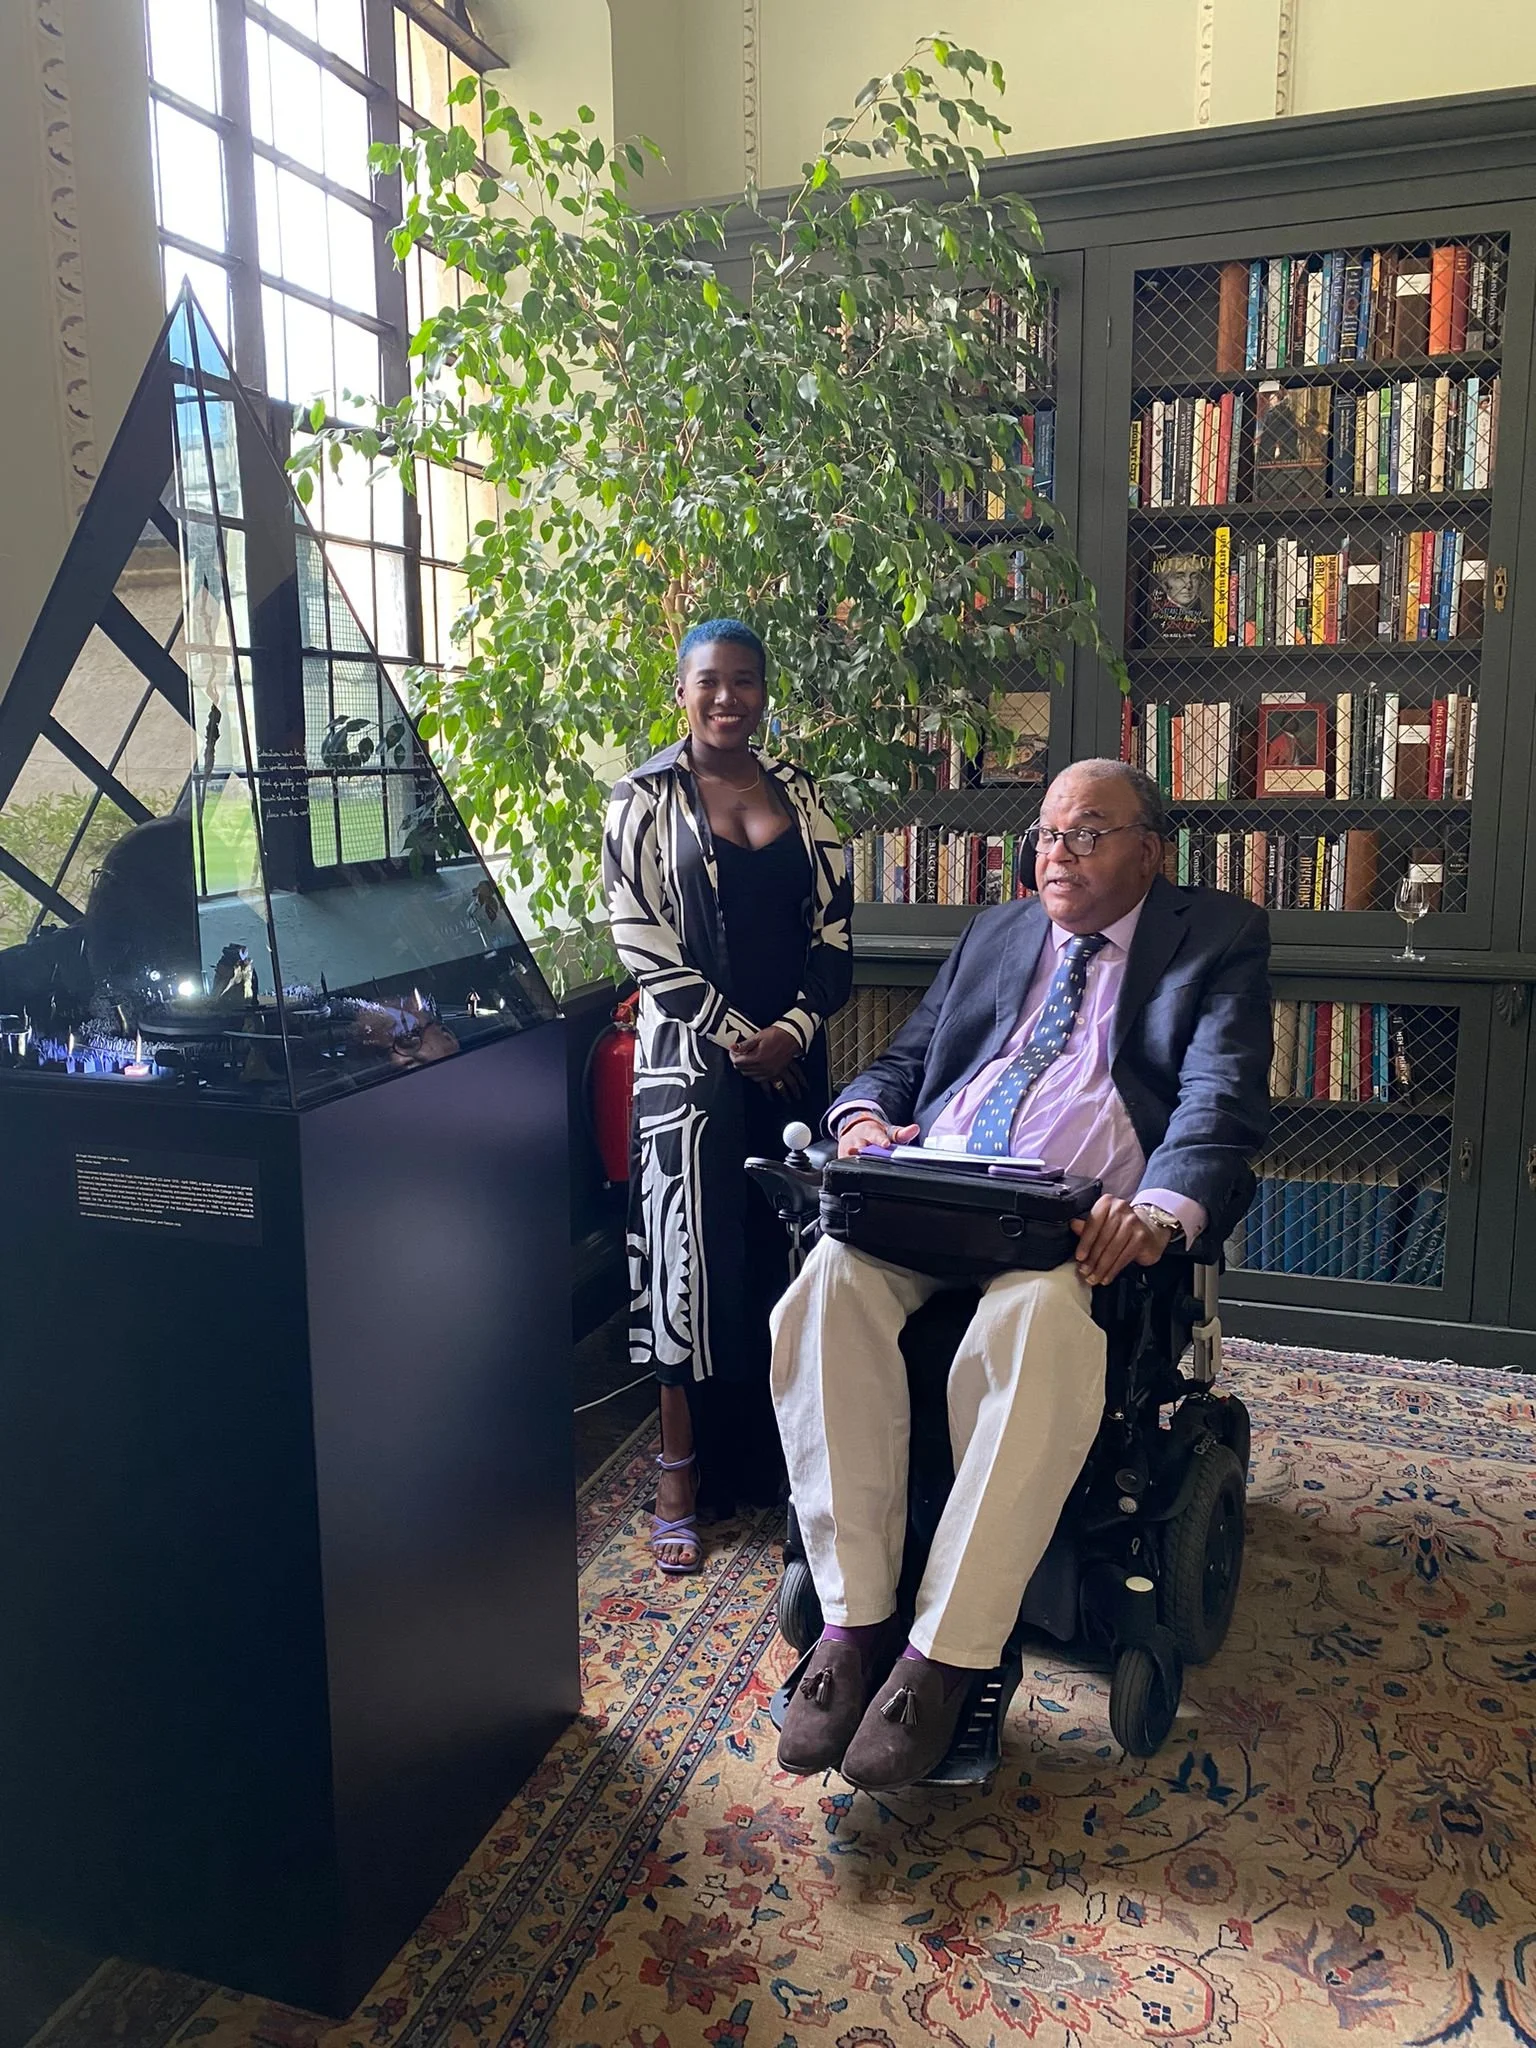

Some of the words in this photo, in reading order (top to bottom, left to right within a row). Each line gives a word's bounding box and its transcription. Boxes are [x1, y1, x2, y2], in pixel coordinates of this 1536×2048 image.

[928, 842, 936, 872] BLACK
[927, 877, 936, 900] JOKE
[1297, 856, 1314, 909] DIVISIONS
[1396, 1031, 1404, 1045] MEN
